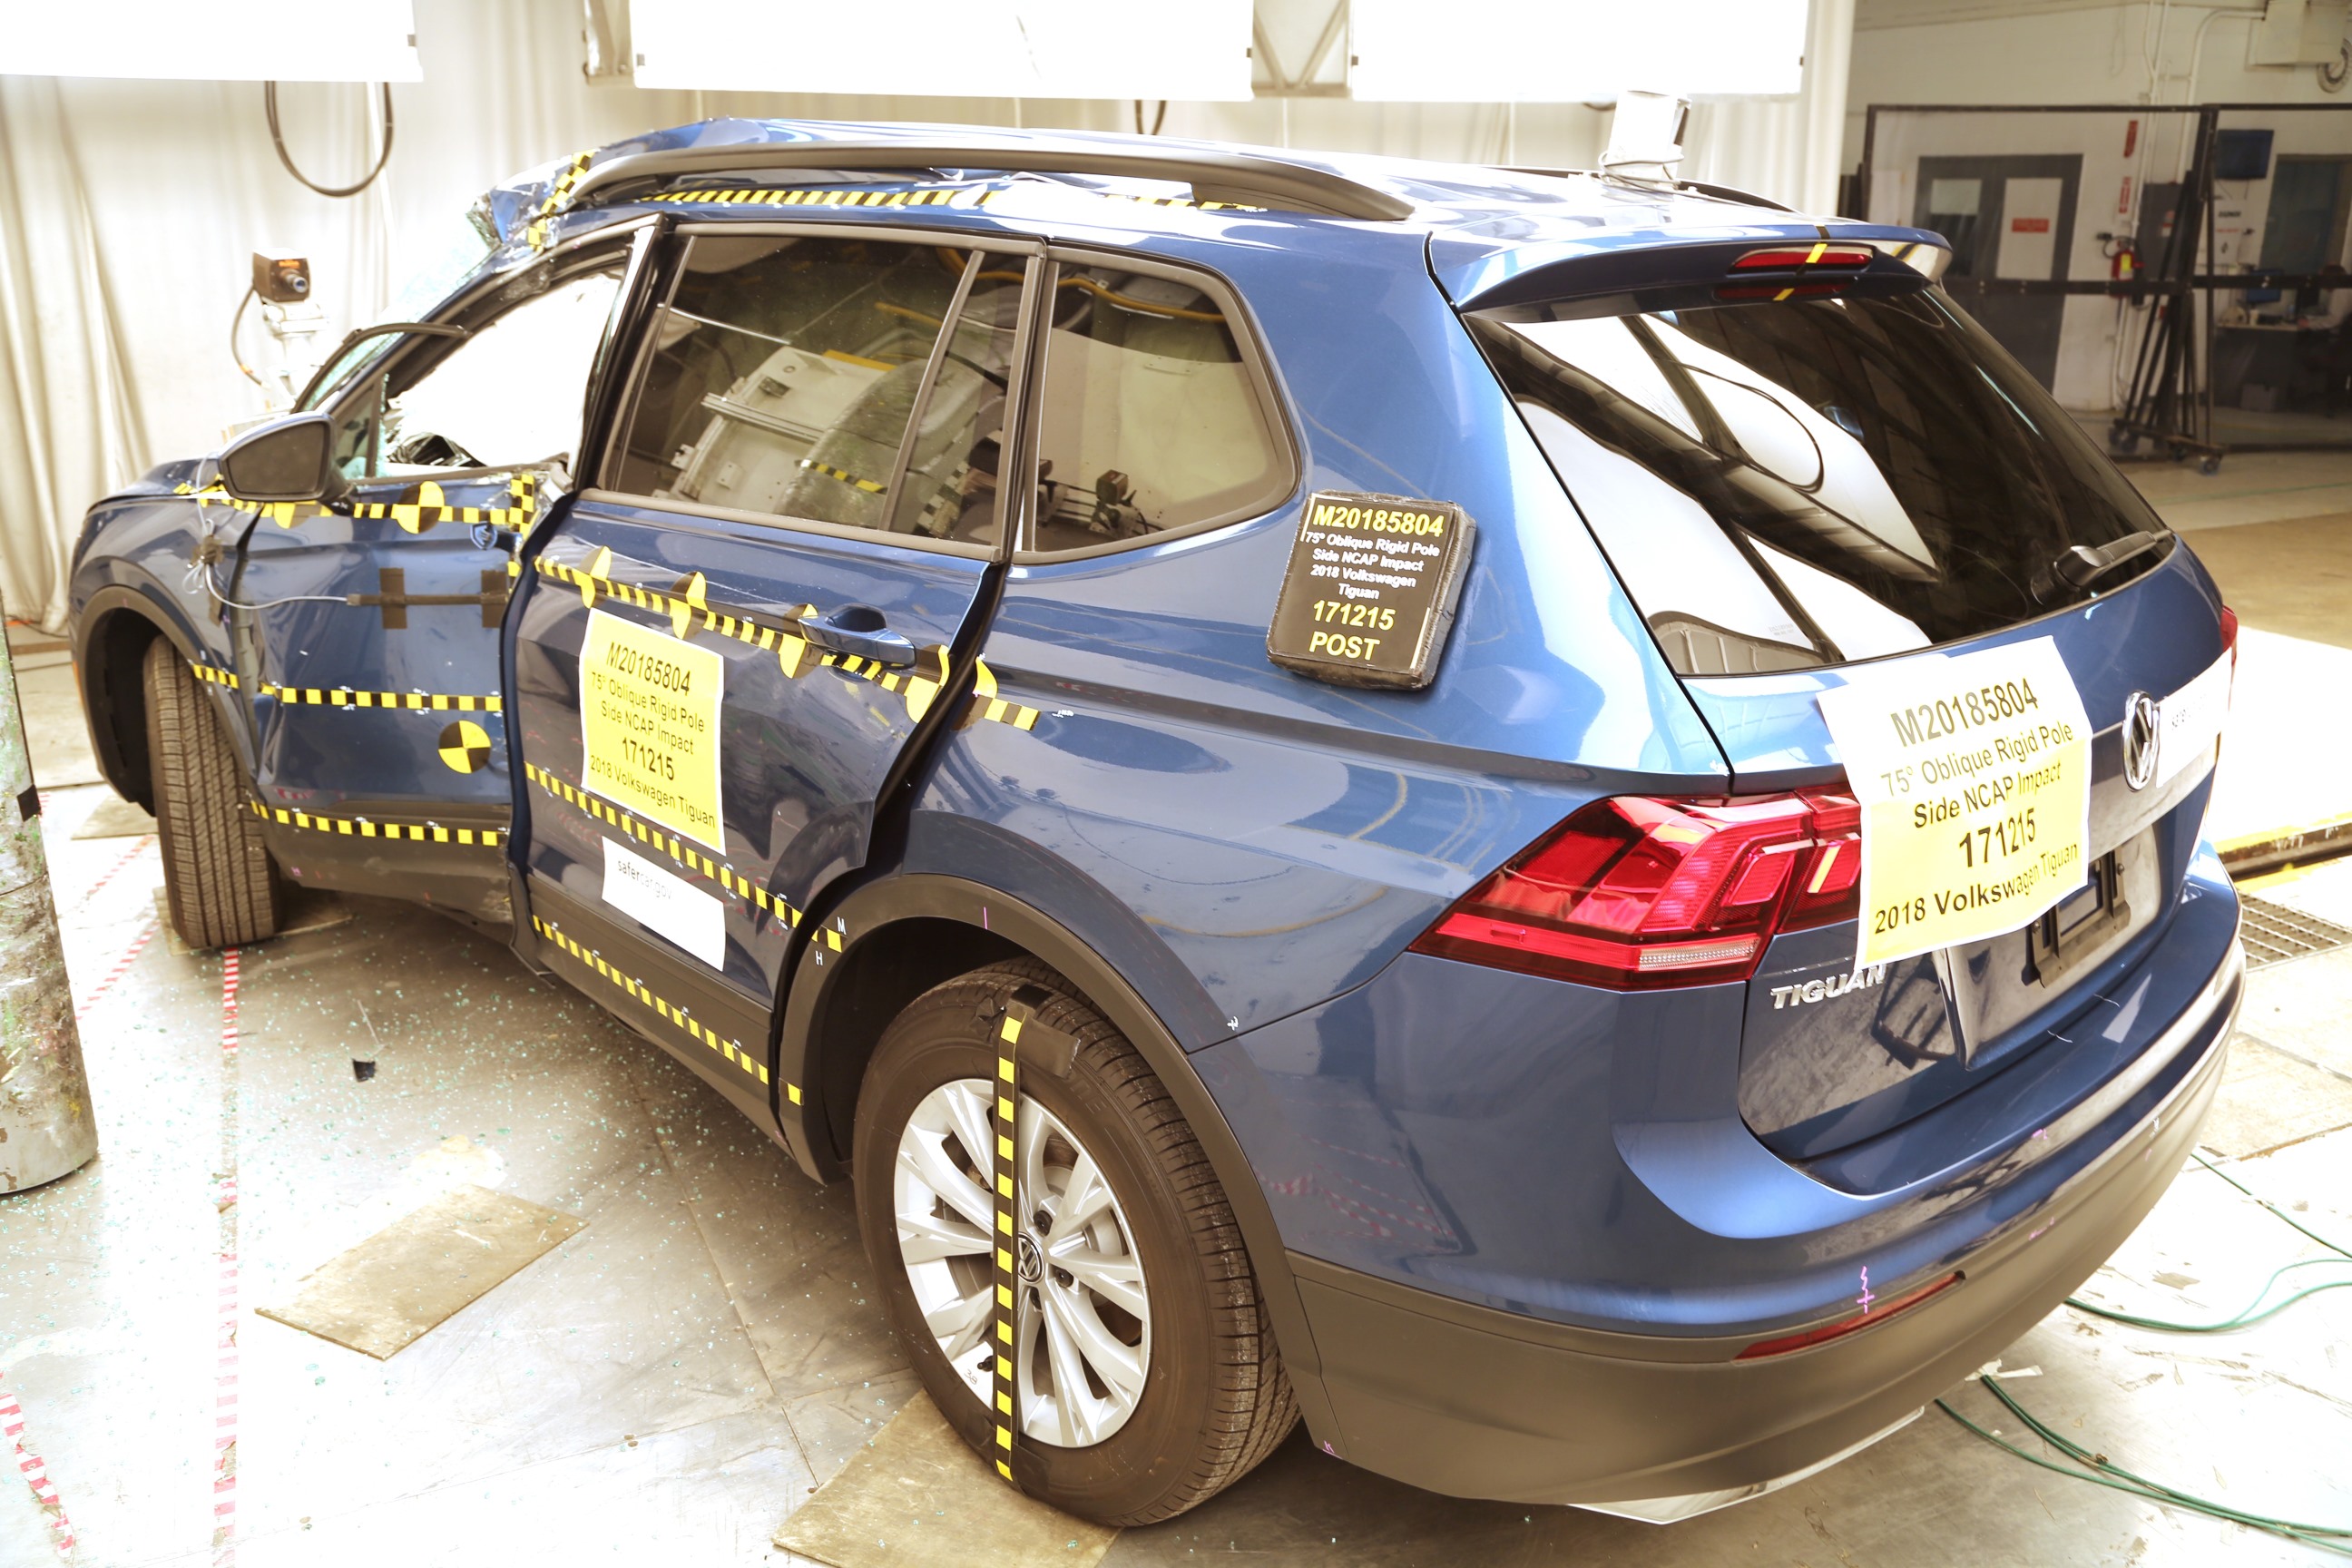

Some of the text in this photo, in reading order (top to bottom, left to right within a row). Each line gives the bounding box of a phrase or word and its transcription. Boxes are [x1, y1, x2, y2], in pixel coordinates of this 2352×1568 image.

[1313, 505, 1445, 537] M20185804
[1312, 548, 1425, 572] Side NCAP Impact
[1327, 534, 1374, 551] Oblique
[1376, 538, 1409, 554] Rigid
[1411, 543, 1441, 557] Pole
[1310, 564, 1416, 588] 2018 Volkswagen
[1338, 583, 1380, 600] Tiguan
[1313, 600, 1396, 631] 171215
[606, 642, 691, 696] M20185804
[1308, 631, 1380, 661] POST
[602, 701, 693, 755] Side NCAP Impact
[609, 679, 647, 709] Oblique
[650, 695, 677, 721] Rigid
[681, 708, 704, 732] Pole
[1890, 678, 2039, 747] M20185804
[622, 737, 675, 780] 171215
[1921, 749, 1994, 785] Oblique
[1994, 730, 2039, 763] Rigid
[2039, 720, 2074, 749] Pole
[591, 755, 715, 828] 2018 Volkswagen Tiguan
[1915, 761, 2062, 828] Side NCAP Impact
[1959, 807, 2036, 867] 171215
[618, 860, 672, 899] safercar.gov
[1875, 843, 2078, 935] 2018 Volkswagen Tiguan
[1770, 963, 1887, 1010] TIGUAN
